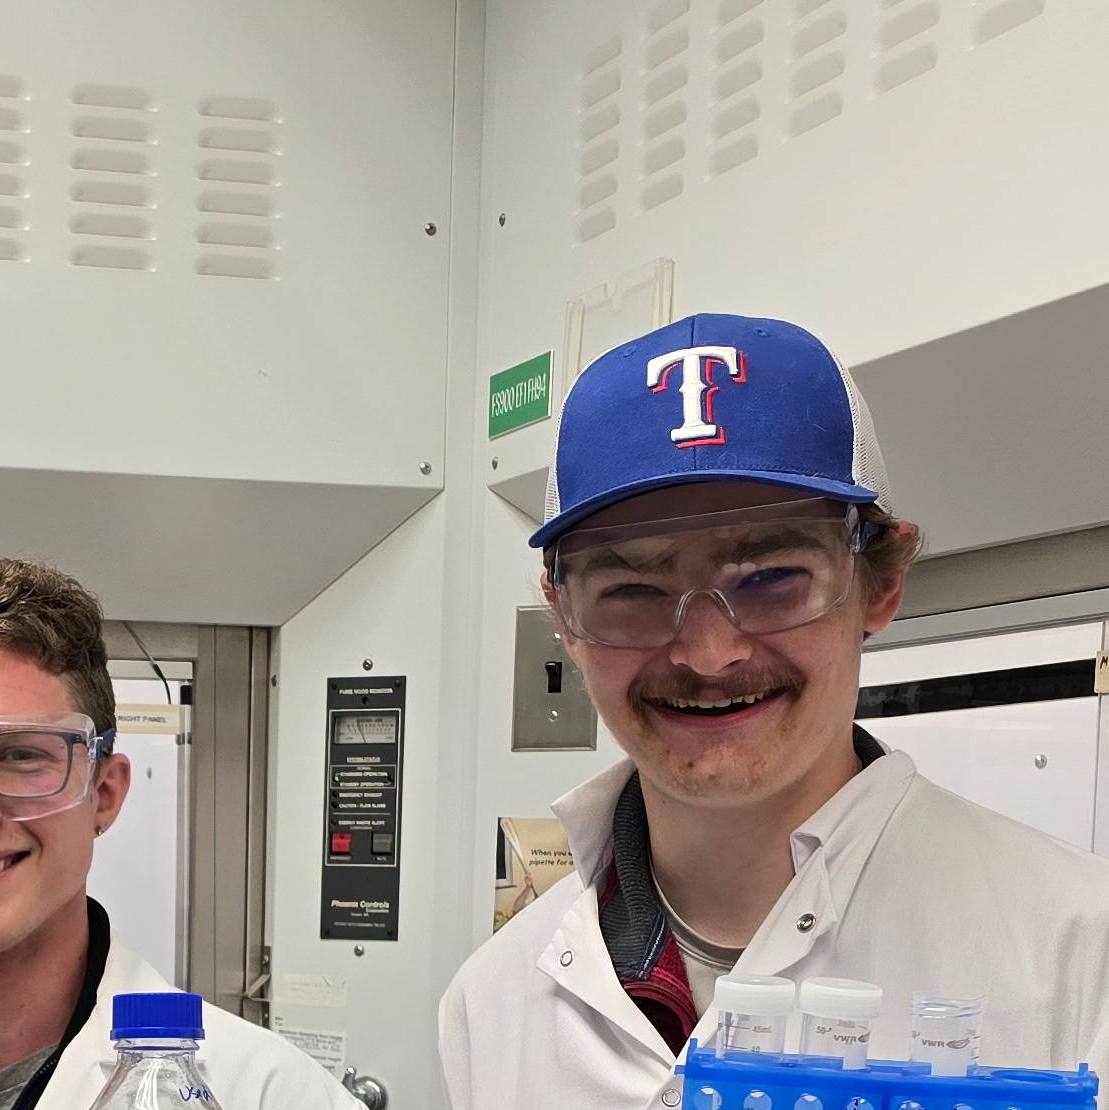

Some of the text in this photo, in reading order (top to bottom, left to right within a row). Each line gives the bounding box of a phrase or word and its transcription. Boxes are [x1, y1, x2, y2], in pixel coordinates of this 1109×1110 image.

[647, 346, 747, 448] T
[530, 848, 552, 857] When
[921, 1038, 945, 1048] VWR
